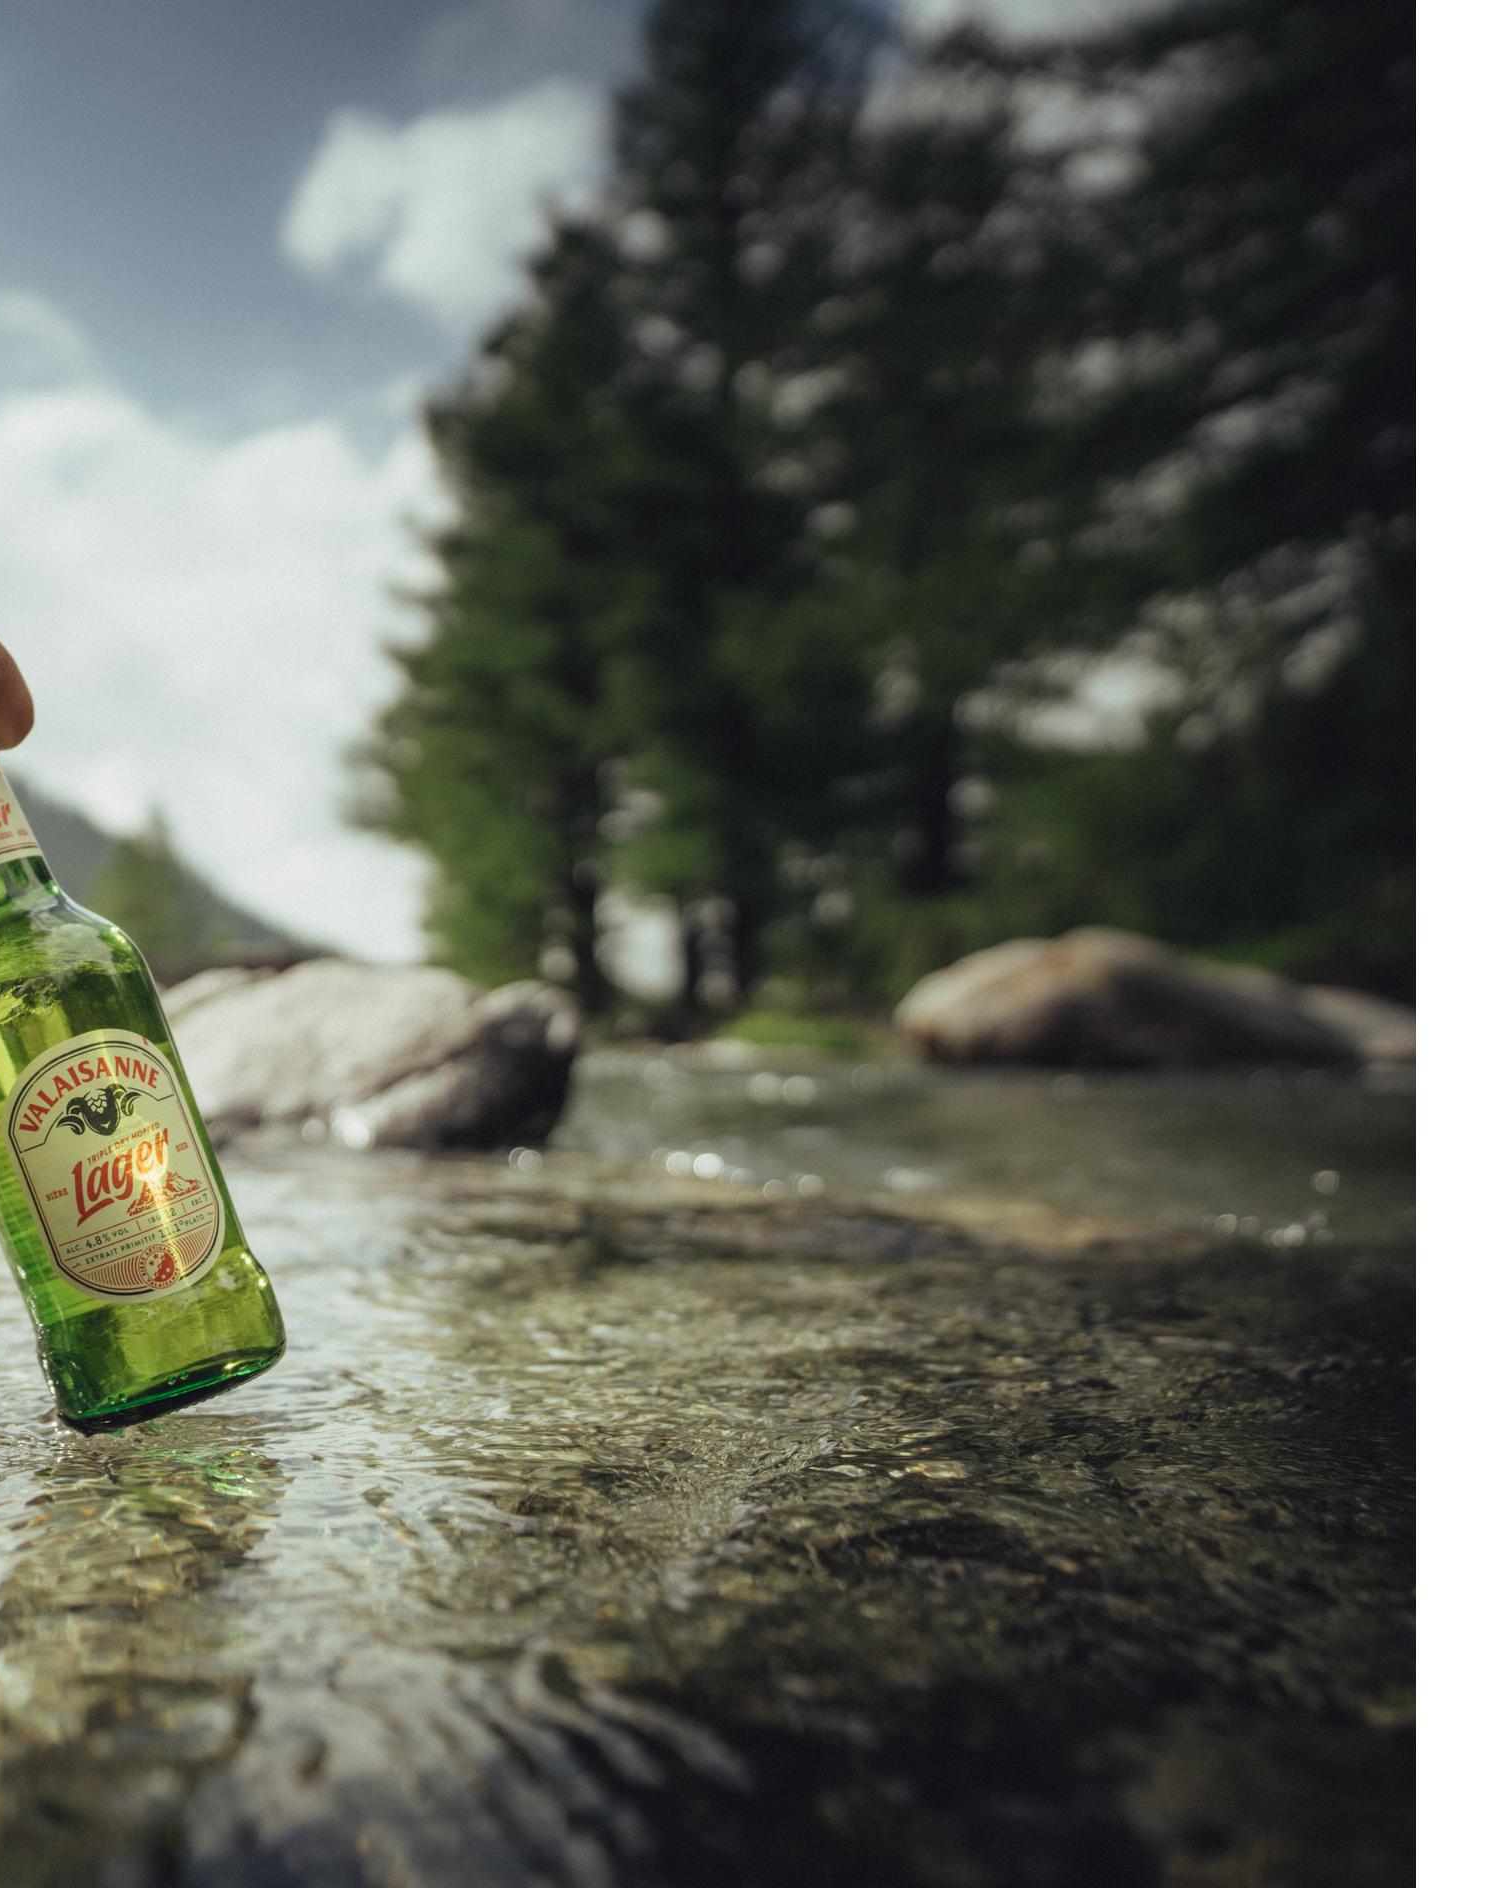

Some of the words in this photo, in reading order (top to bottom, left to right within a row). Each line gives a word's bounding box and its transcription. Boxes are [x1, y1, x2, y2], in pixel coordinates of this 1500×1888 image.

[18, 1056, 160, 1133] VALAISANNE
[87, 1145, 113, 1165] TRIPLE
[114, 1137, 130, 1150] DRY
[131, 1122, 160, 1140] HOPPED
[71, 1128, 169, 1228] Lager
[66, 1245, 84, 1254] ALC.
[85, 1232, 111, 1248] 4.8%
[111, 1227, 129, 1237] VOL
[85, 1248, 118, 1264] EXTRAIT
[120, 1232, 156, 1251] PRIMITIF
